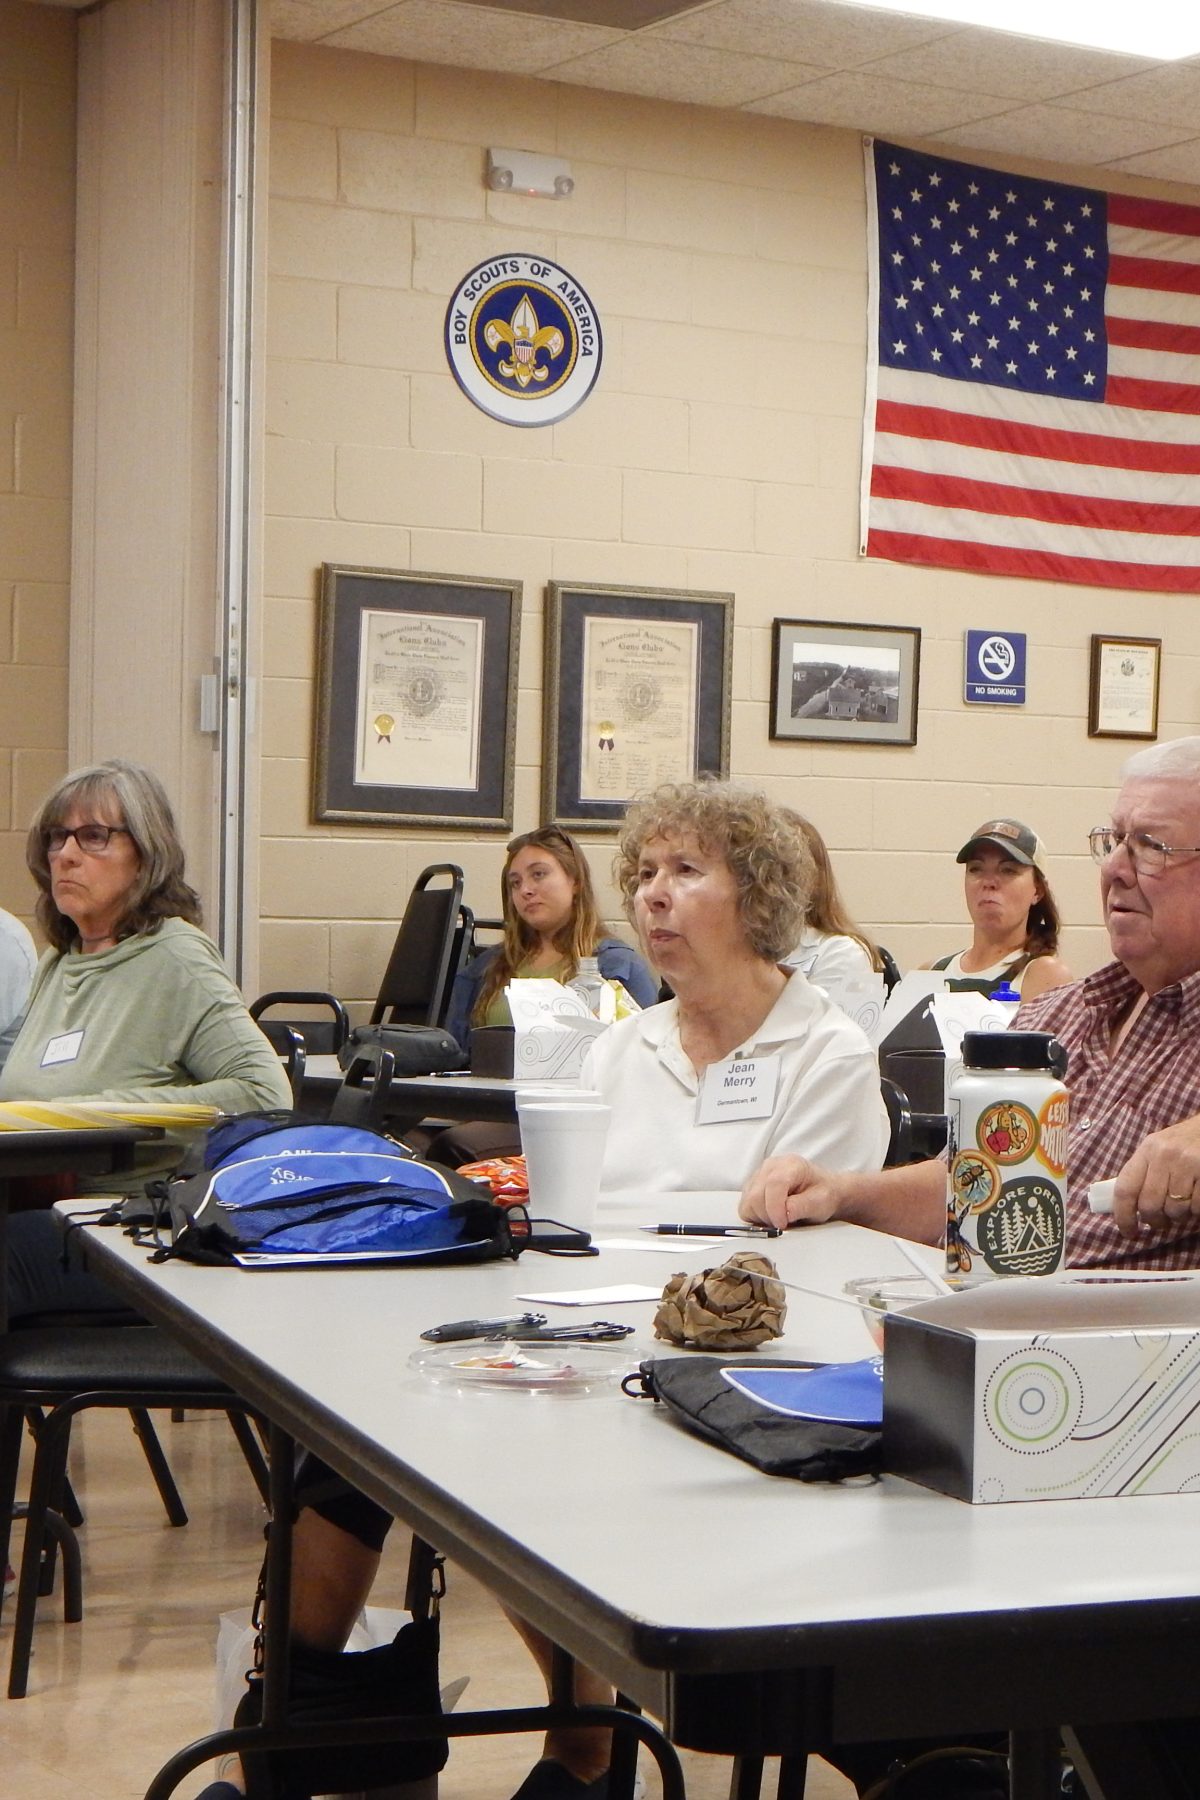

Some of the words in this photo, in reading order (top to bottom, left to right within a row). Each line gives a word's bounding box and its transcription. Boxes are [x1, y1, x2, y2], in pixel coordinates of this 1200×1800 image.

[454, 309, 468, 345] BOY
[463, 260, 520, 301] SCOUTS
[530, 262, 551, 279] OF
[557, 281, 594, 357] AMERICA
[975, 686, 985, 694] NO
[987, 687, 1017, 696] SMOKING
[728, 1063, 755, 1074] Jean
[724, 1076, 756, 1087] Merry
[986, 1186, 1026, 1251] EXPLORE
[1033, 1186, 1062, 1239] OREGON
